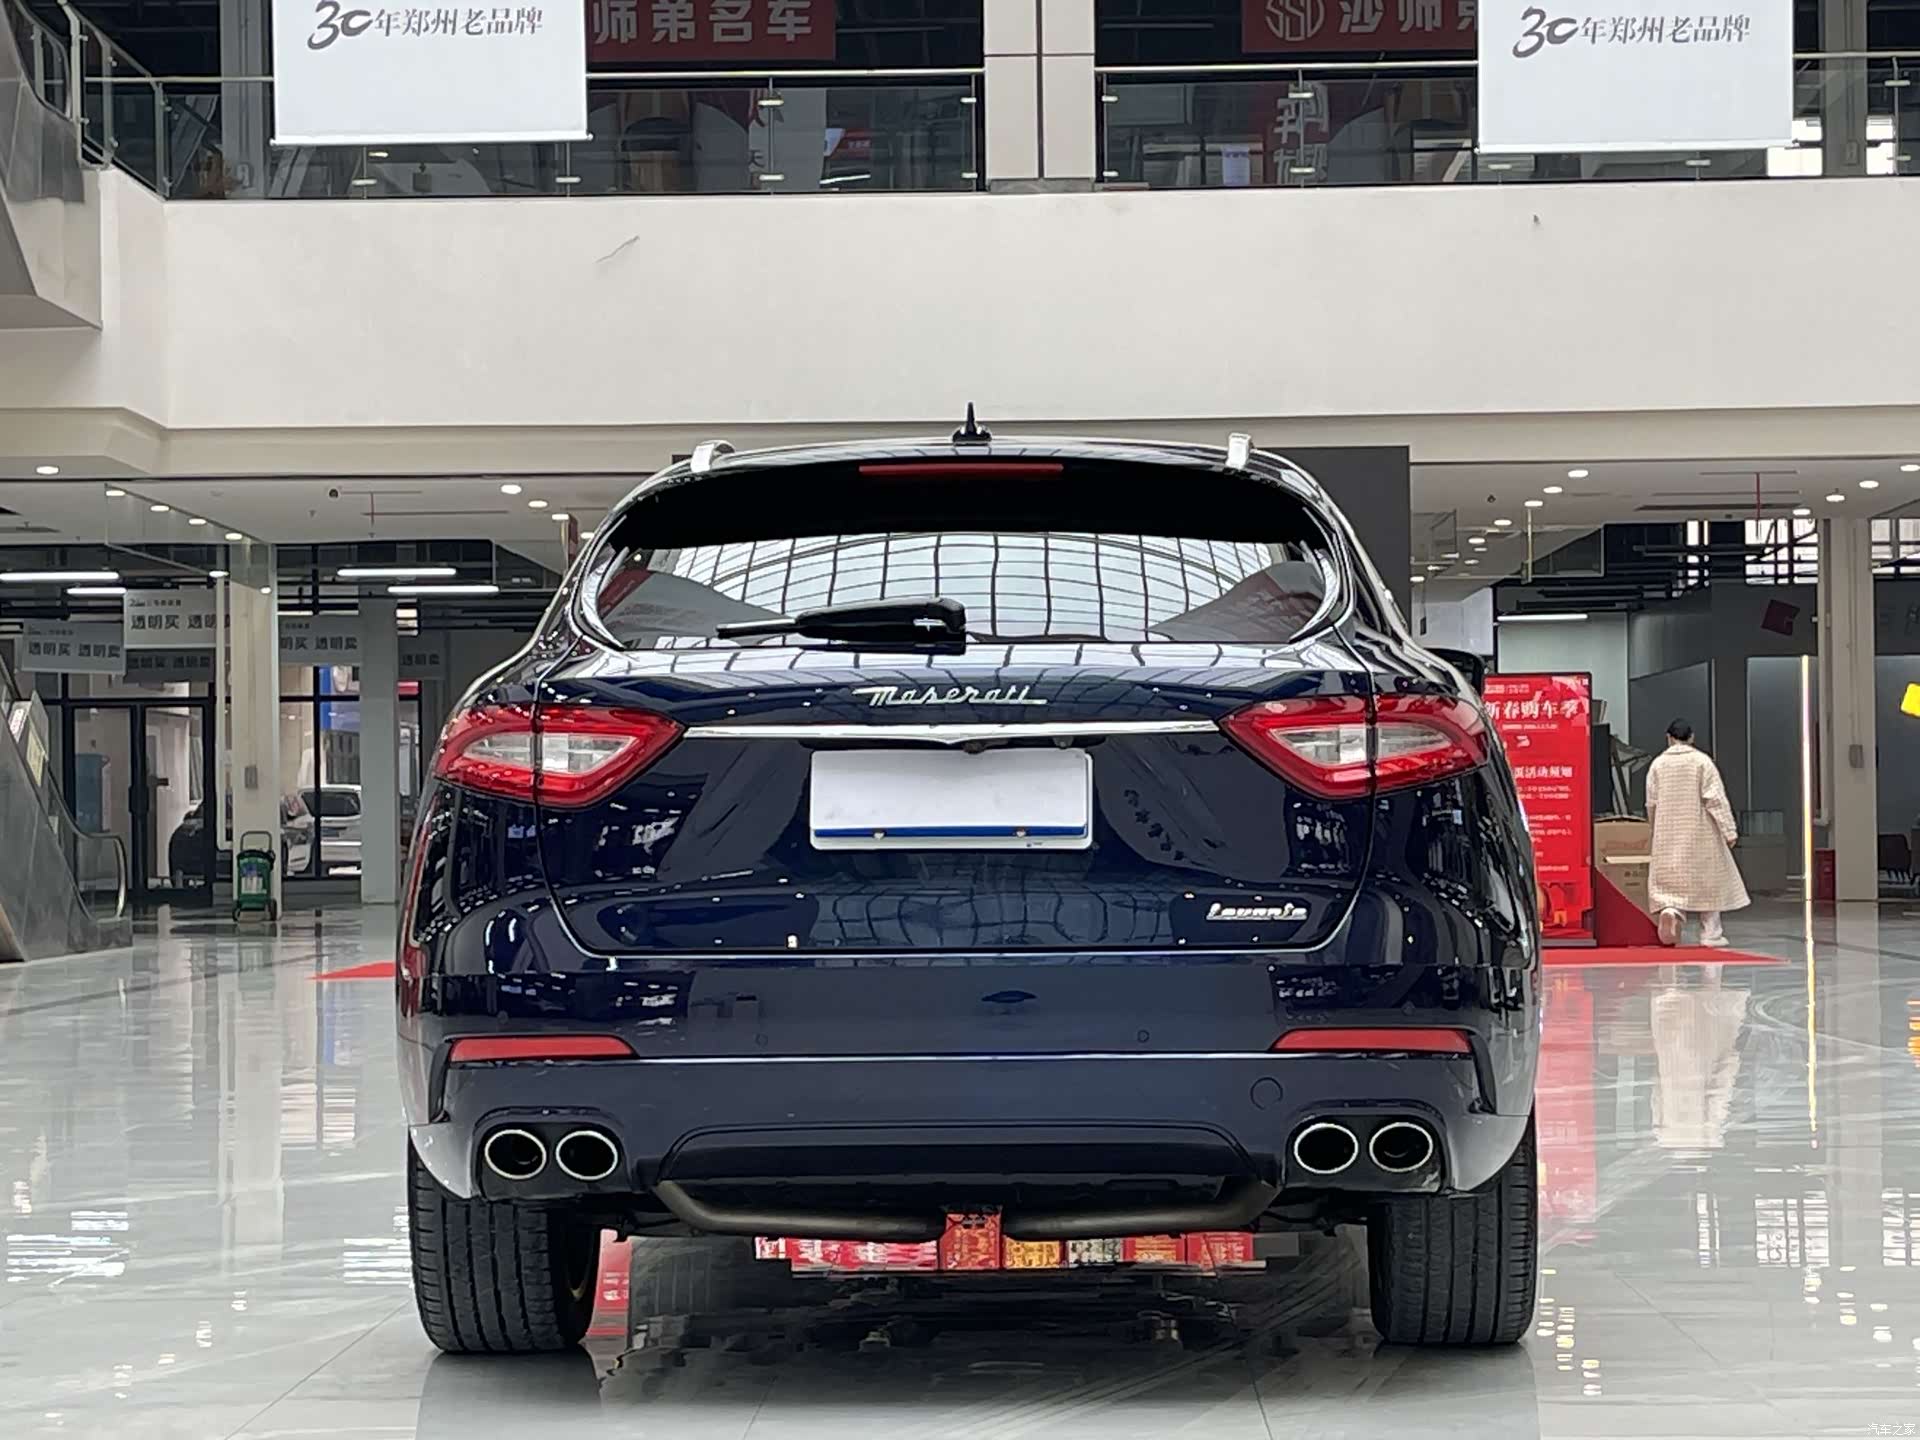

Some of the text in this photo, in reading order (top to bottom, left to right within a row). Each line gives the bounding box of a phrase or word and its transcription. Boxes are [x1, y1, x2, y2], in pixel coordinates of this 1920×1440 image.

[306, 0, 543, 50] 30年郑州老品牌
[593, 0, 812, 44] 师弟名车
[1338, 0, 1478, 33] 沙师
[1511, 6, 1751, 58] 30年郑州老品牌
[852, 686, 1048, 706] Maserati
